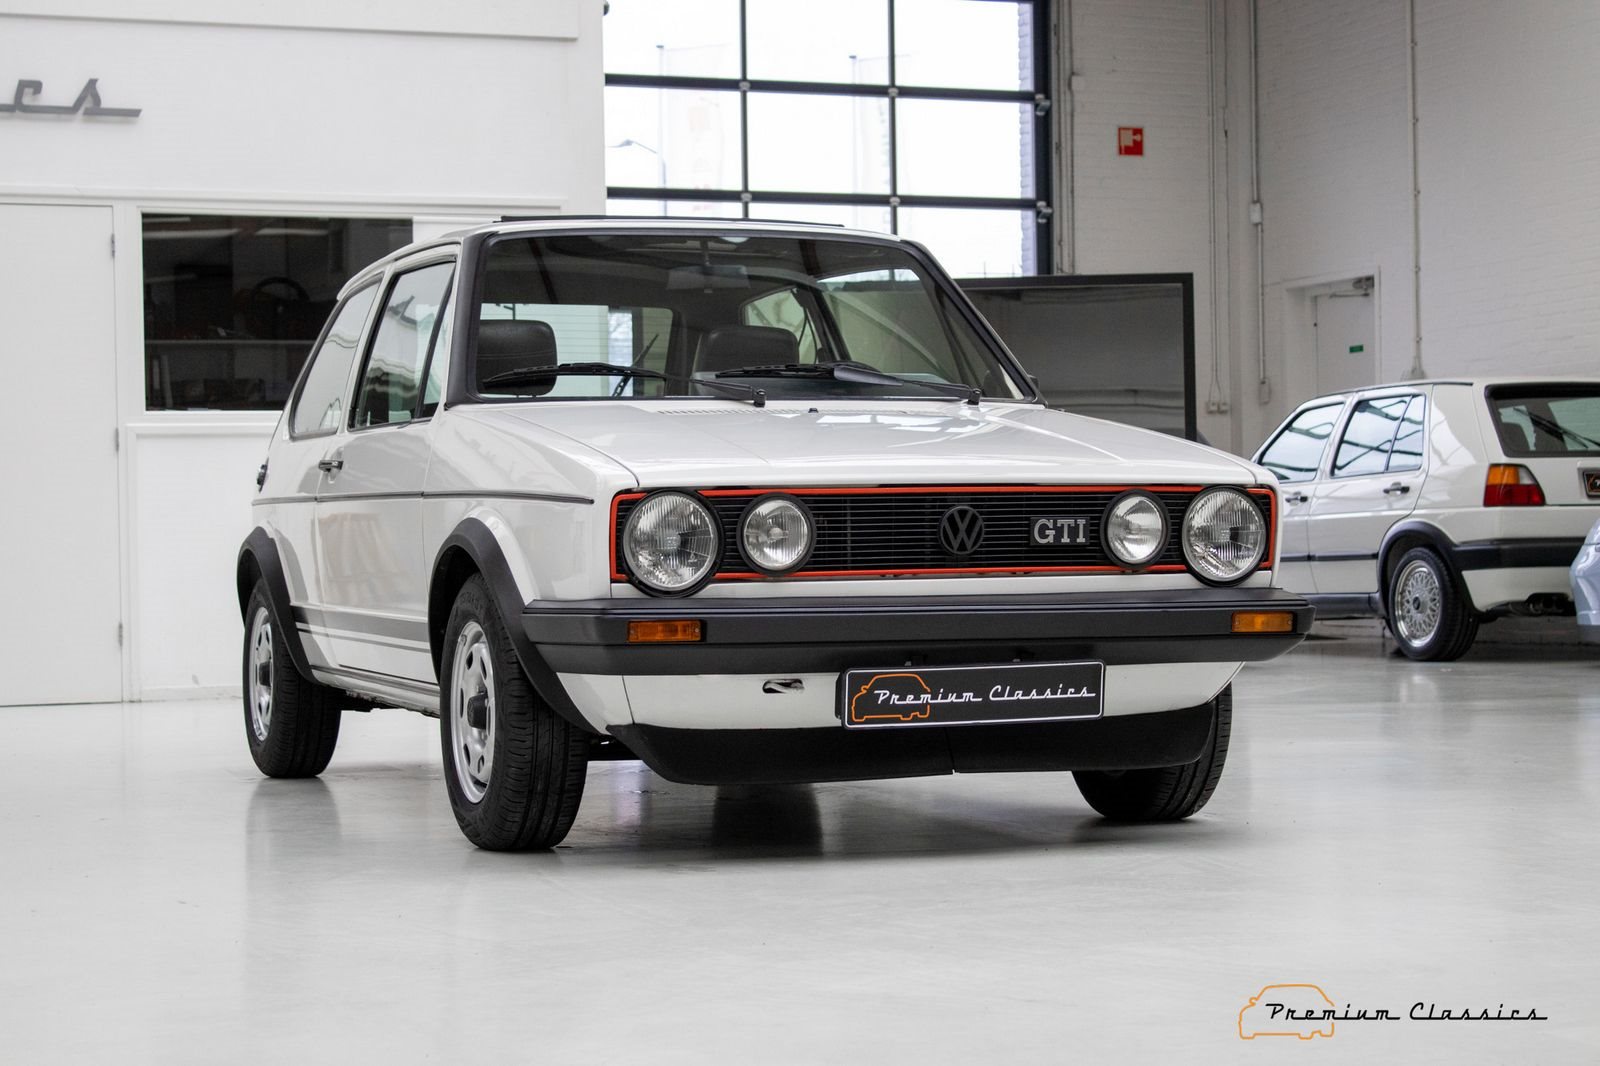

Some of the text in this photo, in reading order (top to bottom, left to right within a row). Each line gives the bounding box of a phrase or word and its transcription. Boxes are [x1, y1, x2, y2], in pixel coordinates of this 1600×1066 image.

[940, 505, 985, 555] VW
[1033, 518, 1087, 544] GTI
[873, 683, 1096, 705] Premium Classics
